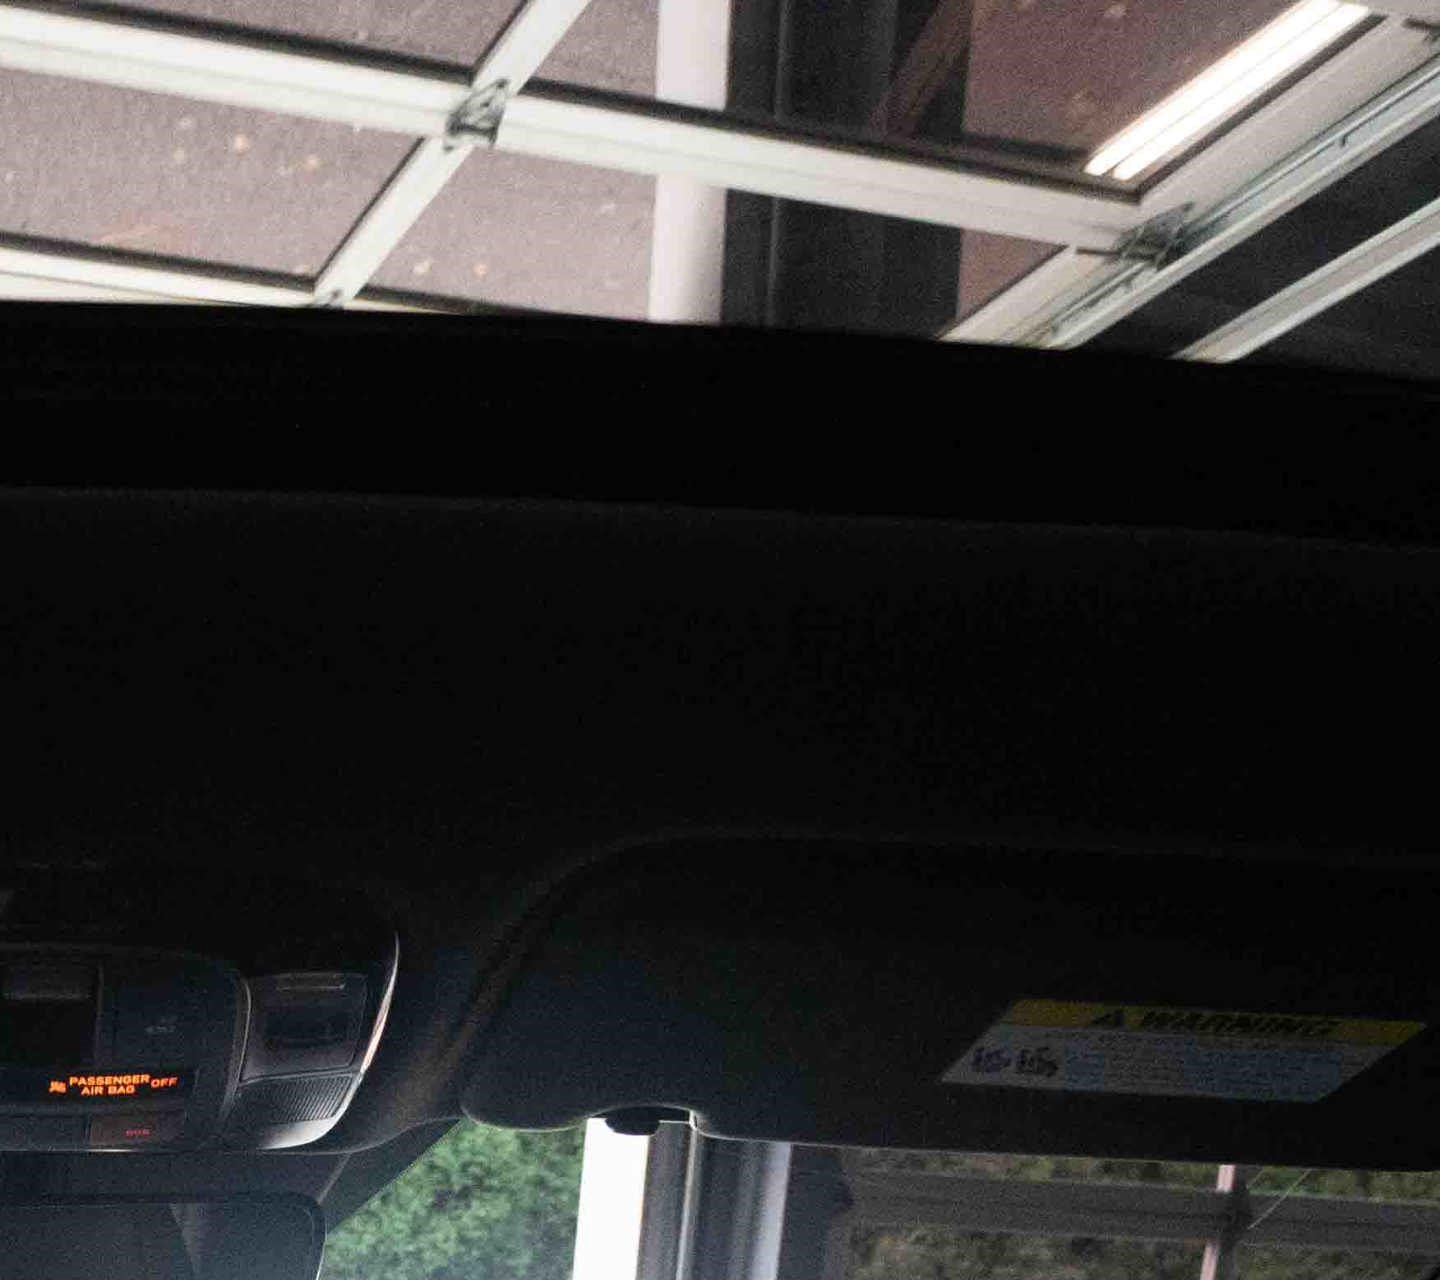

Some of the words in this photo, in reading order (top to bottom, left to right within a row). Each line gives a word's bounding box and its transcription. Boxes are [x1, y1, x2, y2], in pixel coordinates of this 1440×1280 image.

[69, 1074, 150, 1086] PASSENGER
[150, 1077, 177, 1088] OFF
[81, 1085, 103, 1095] AIR
[107, 1085, 136, 1095] BAG
